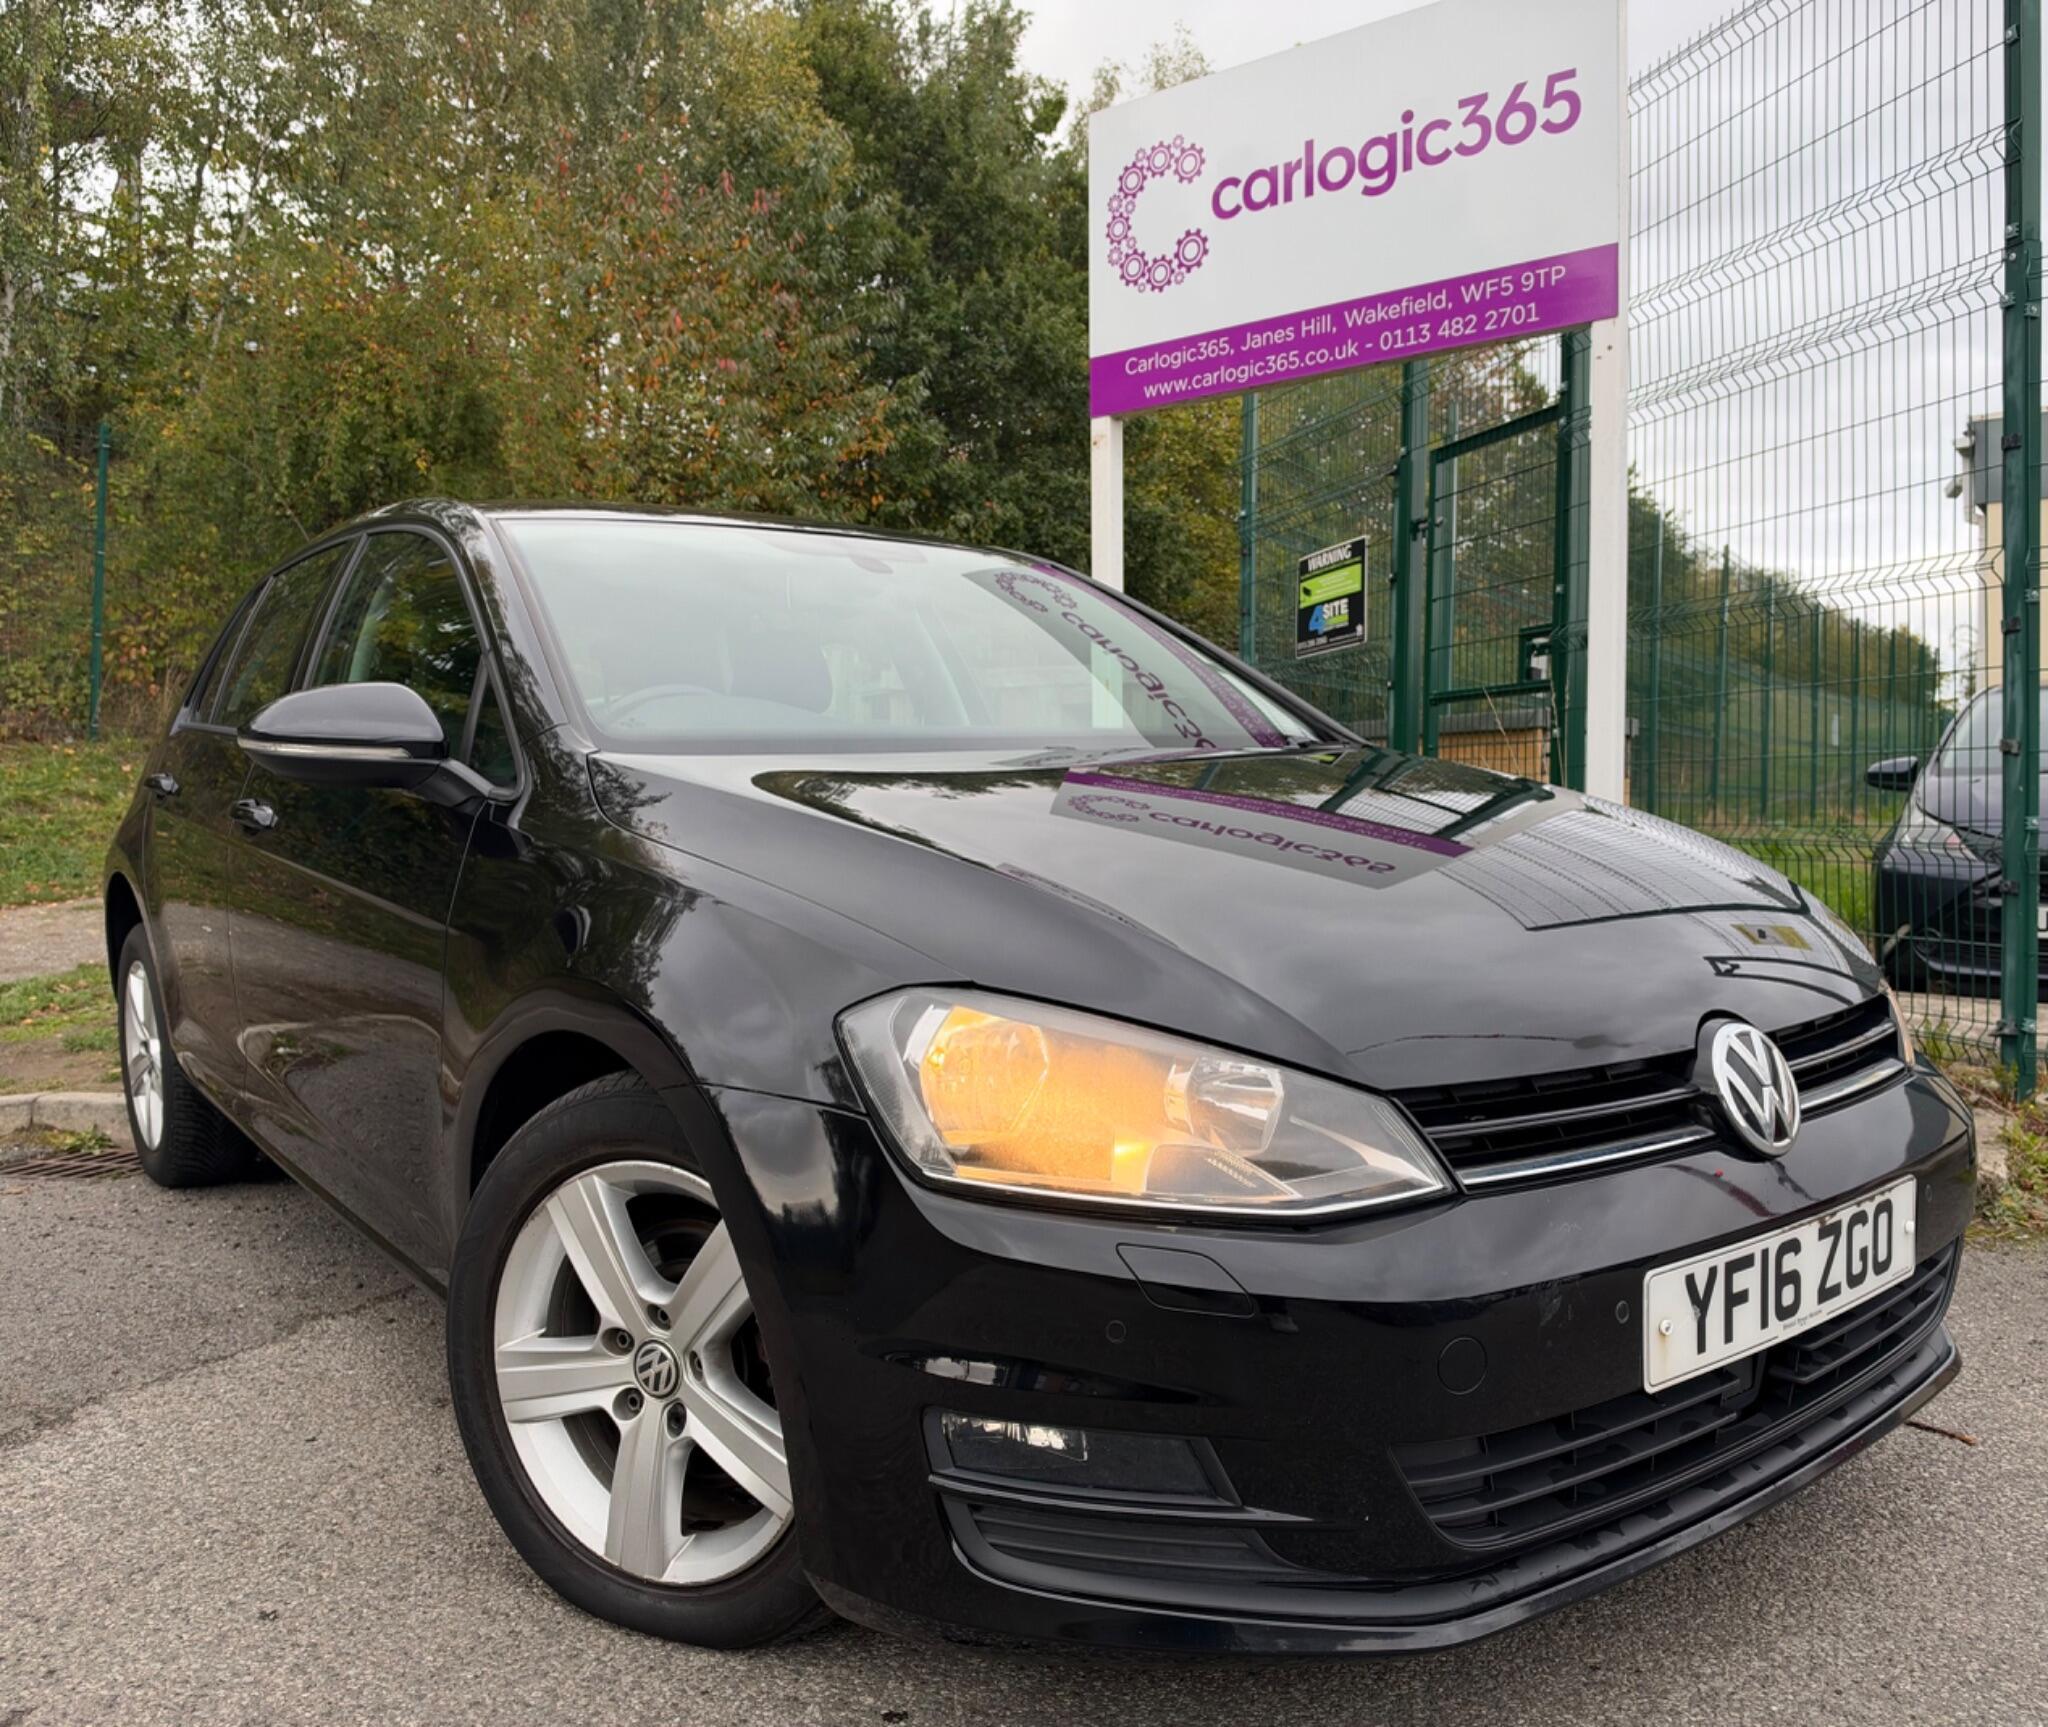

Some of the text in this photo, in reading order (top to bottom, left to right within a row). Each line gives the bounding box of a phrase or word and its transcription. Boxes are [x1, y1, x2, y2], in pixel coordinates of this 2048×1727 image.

[1211, 67, 1582, 220] carlogic365
[1125, 265, 1566, 376] Carlogic365, Janes Hill, Wakefield, WF5 9TP
[1143, 338, 1359, 399] www.carlogic365.co.uk
[1380, 323, 1431, 351] 0113
[1437, 314, 1477, 339] 482
[1484, 302, 1540, 332] 2701
[1307, 544, 1352, 572] WARNING
[1685, 1198, 1893, 1356] YF16 ZGO
